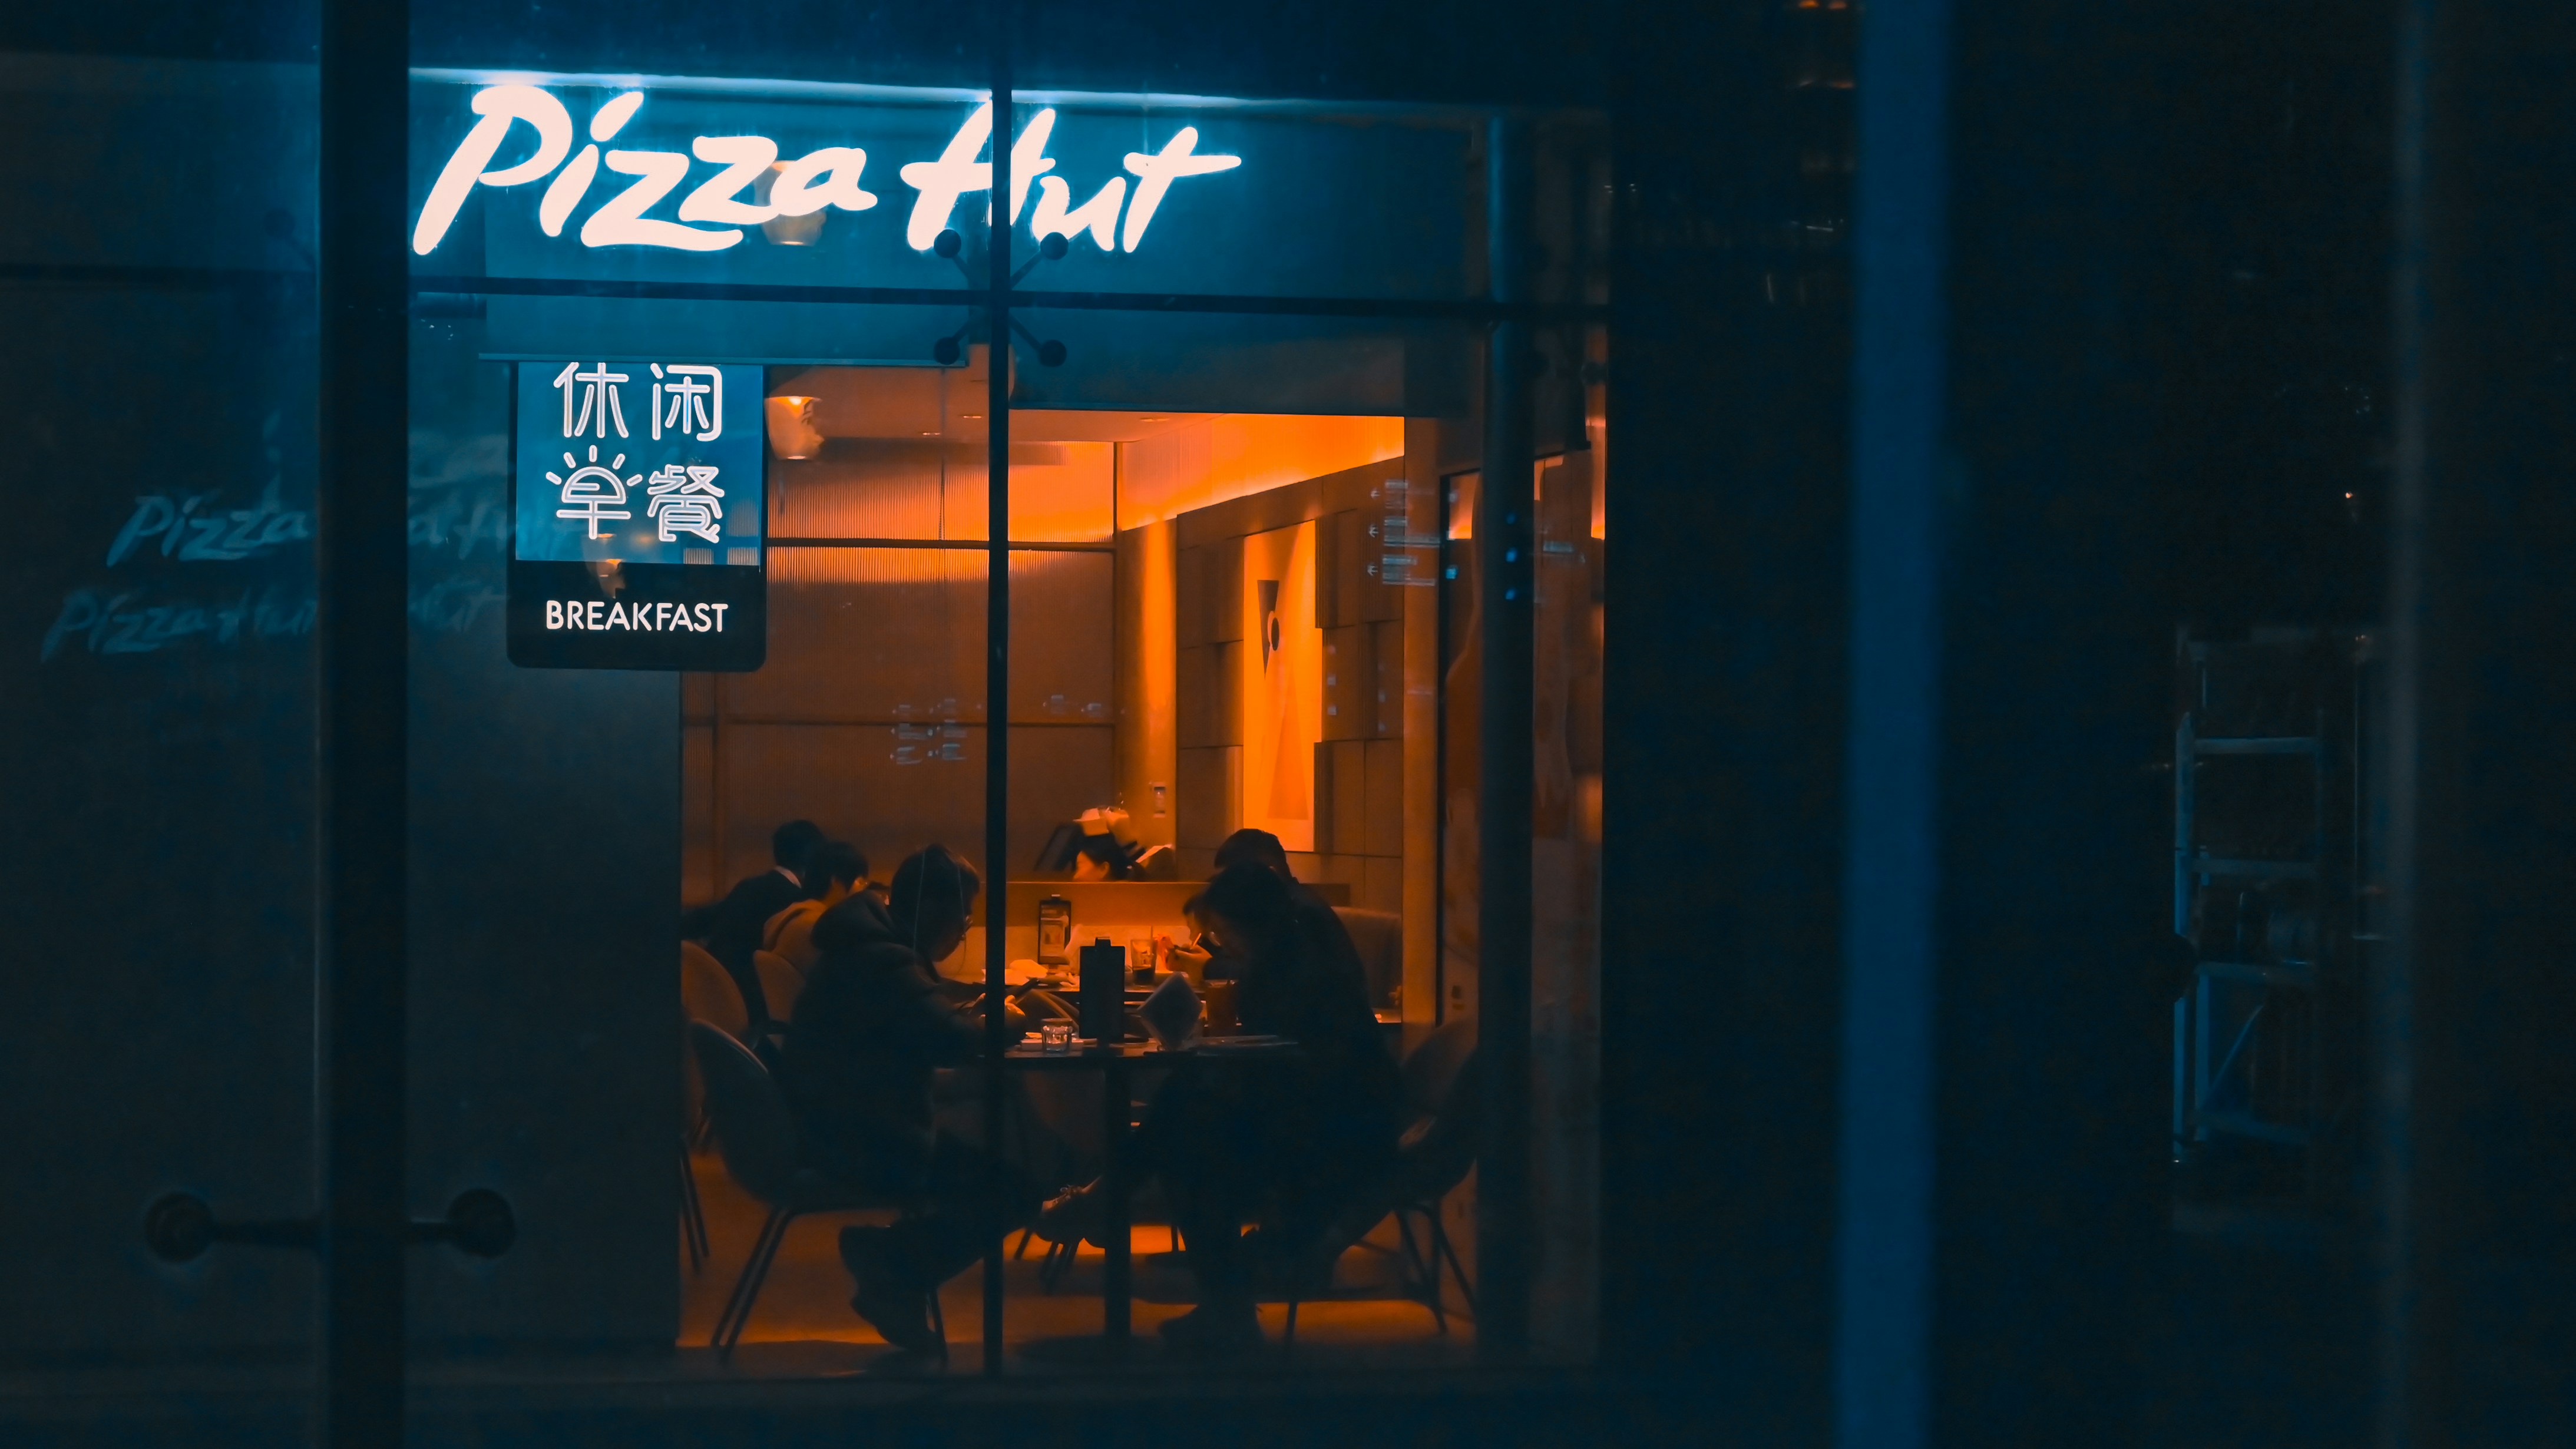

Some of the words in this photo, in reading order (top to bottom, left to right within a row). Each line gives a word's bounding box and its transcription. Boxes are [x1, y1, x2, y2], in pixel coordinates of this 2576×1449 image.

[414, 85, 877, 254] Pizza
[901, 101, 1241, 252] Hut
[554, 362, 722, 441] 休闲
[546, 445, 724, 543] 早餐
[547, 601, 728, 632] BREAKFAST
